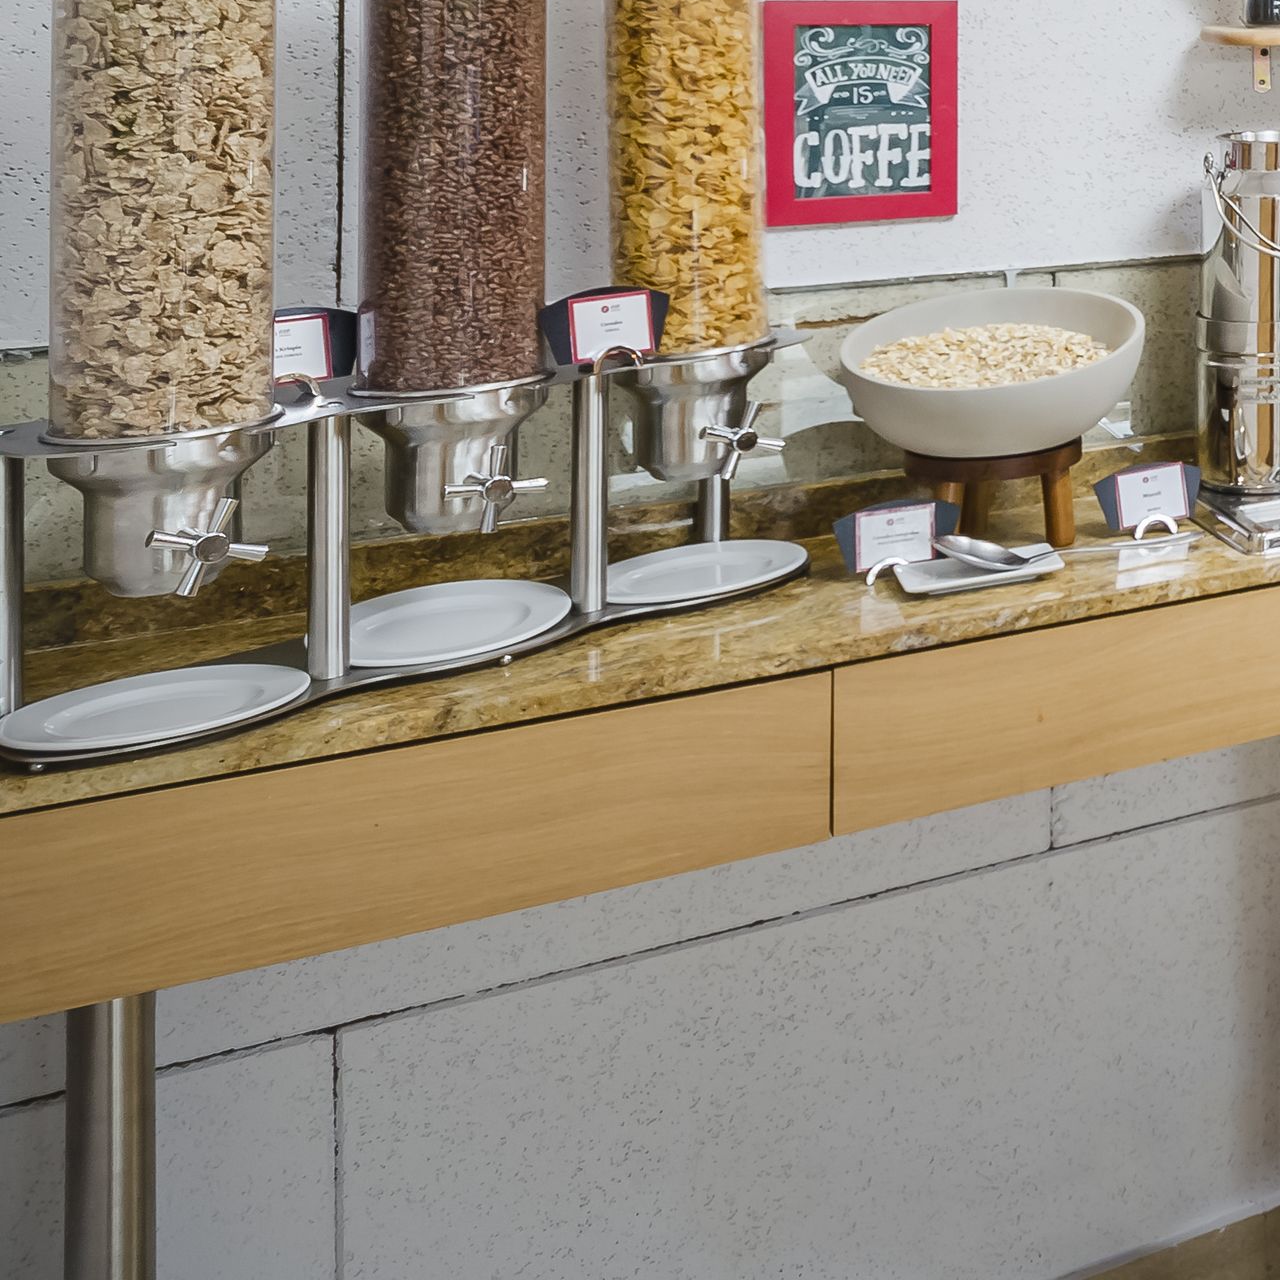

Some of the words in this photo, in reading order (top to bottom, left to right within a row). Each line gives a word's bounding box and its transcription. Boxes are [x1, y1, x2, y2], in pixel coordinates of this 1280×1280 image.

[815, 64, 849, 86] ALL
[848, 63, 878, 80] YOU
[878, 63, 914, 86] NEED
[852, 86, 874, 104] IS
